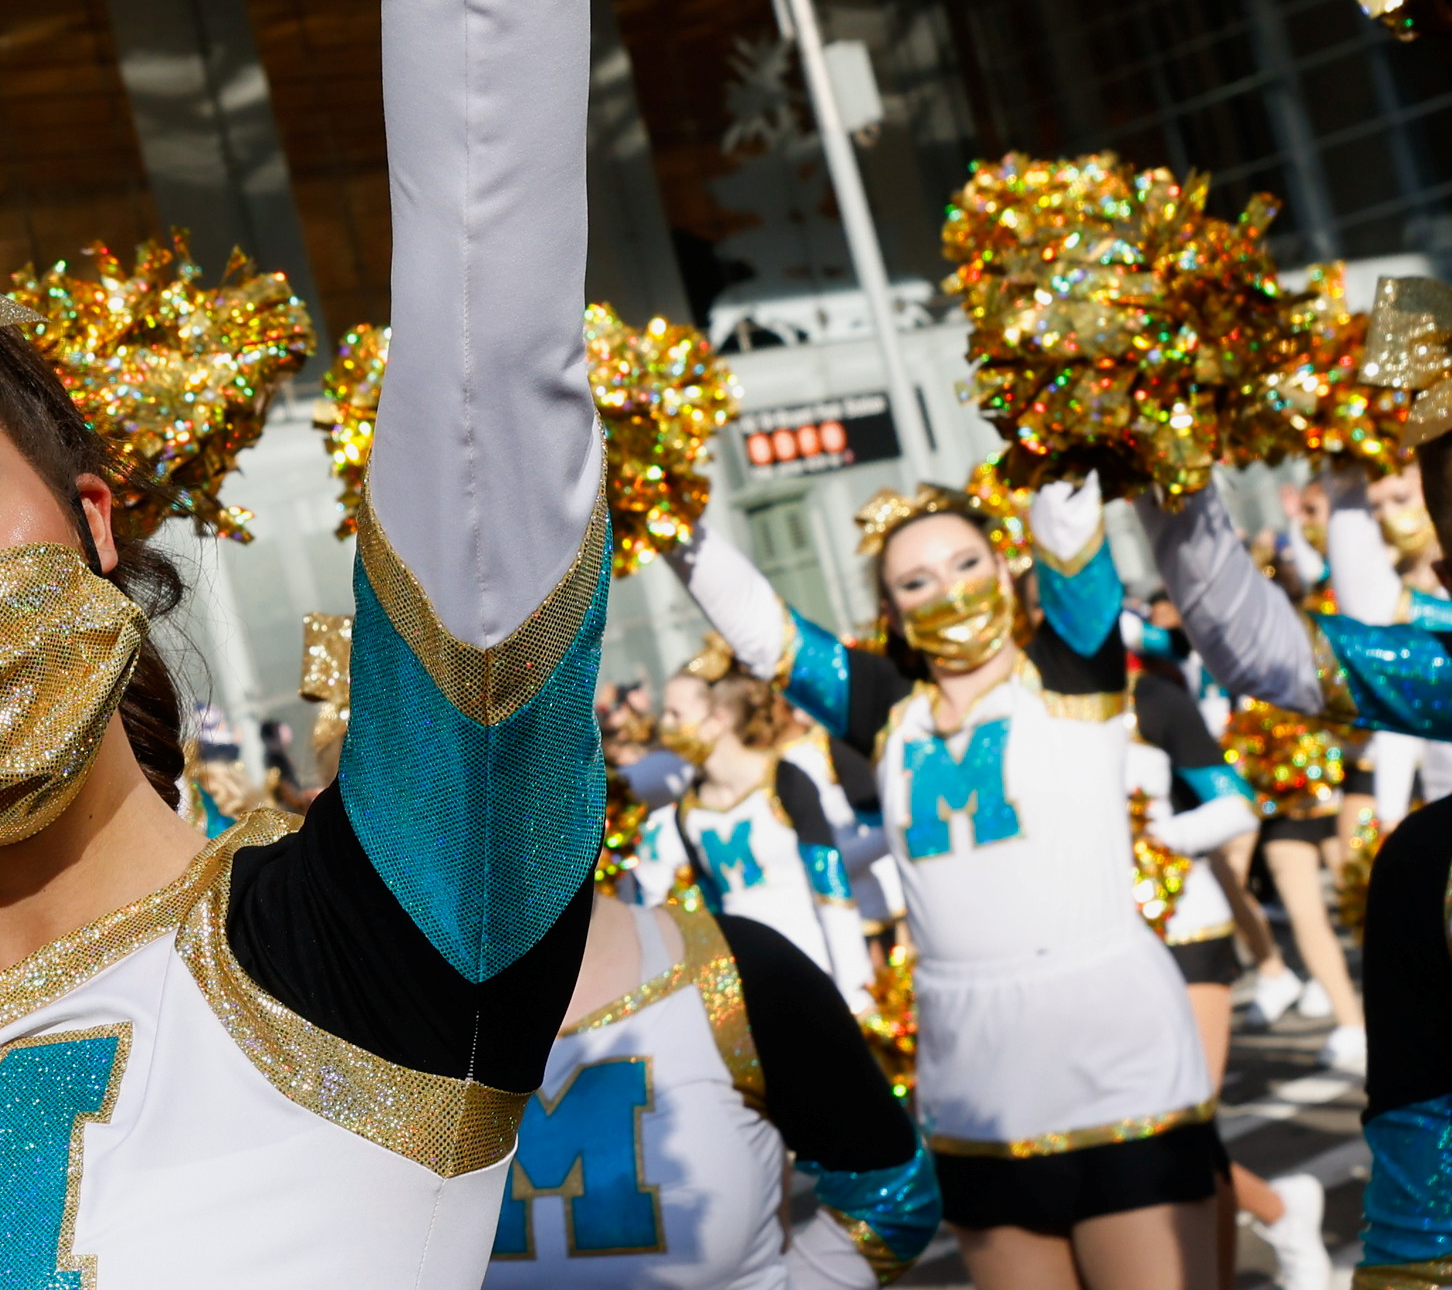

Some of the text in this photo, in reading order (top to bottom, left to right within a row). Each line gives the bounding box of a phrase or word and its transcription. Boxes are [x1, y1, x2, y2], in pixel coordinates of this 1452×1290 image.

[698, 816, 766, 895] M
[901, 717, 1025, 861] M
[490, 1055, 667, 1260] M
